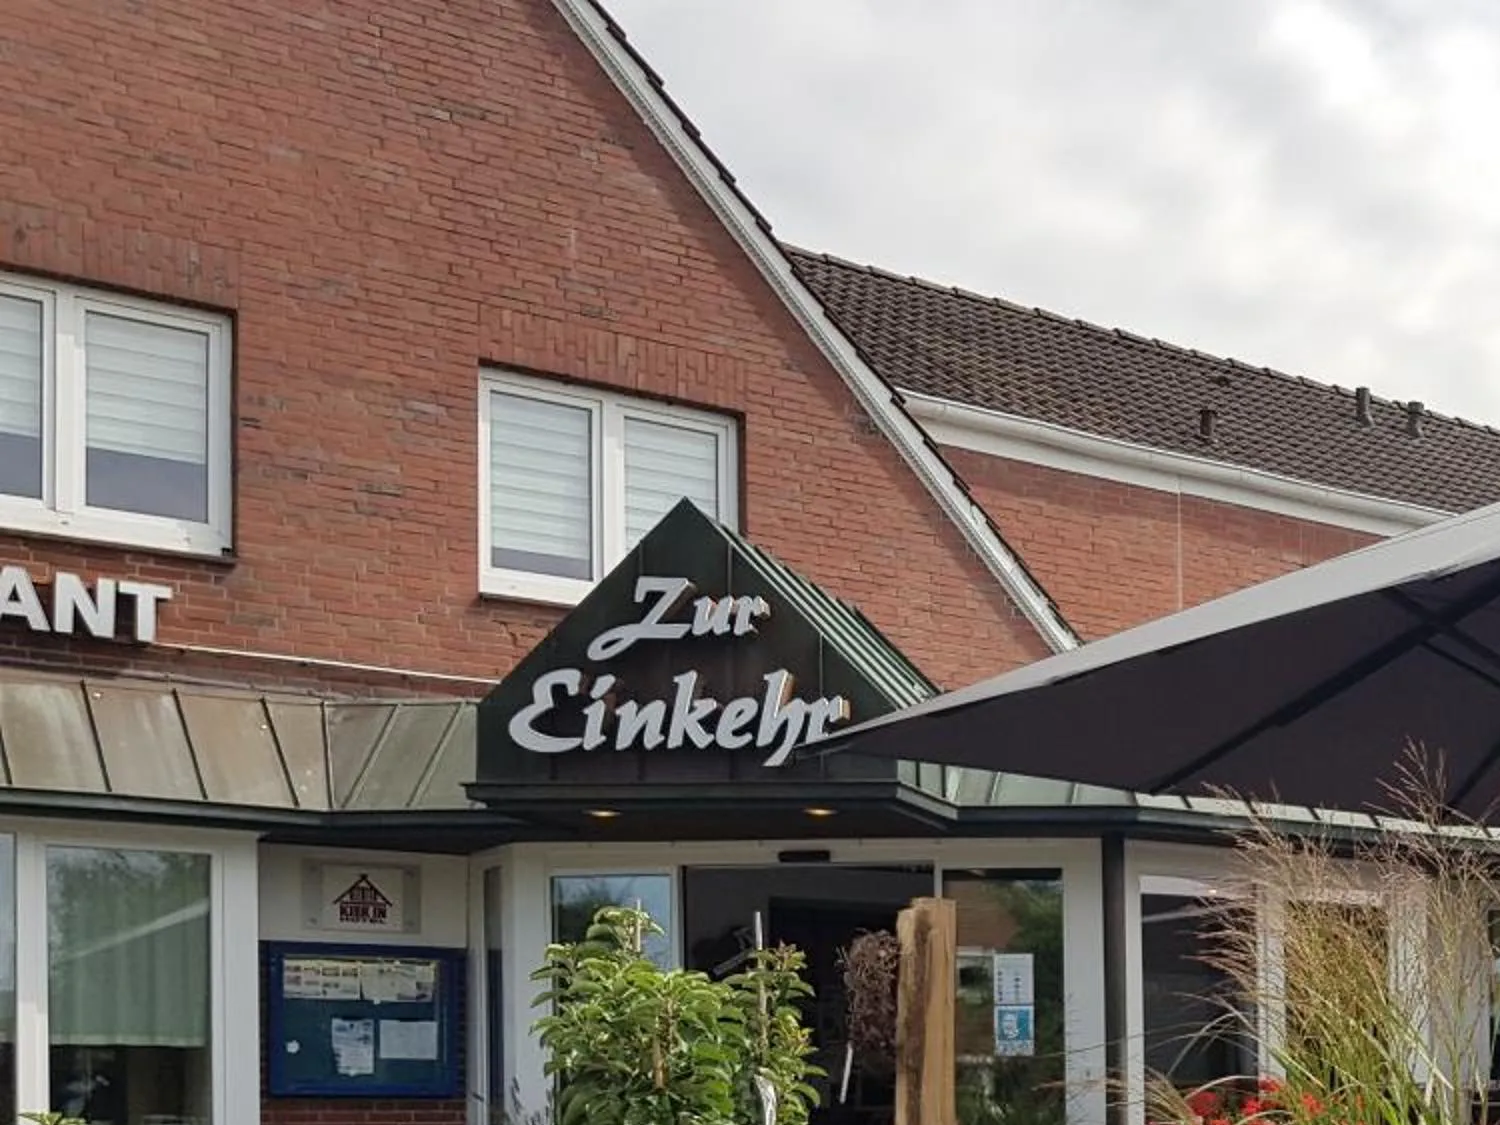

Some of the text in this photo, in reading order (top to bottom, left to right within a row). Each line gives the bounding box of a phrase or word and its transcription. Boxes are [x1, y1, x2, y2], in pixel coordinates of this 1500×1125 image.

[0, 565, 173, 643] ANT
[587, 576, 771, 661] Zur
[508, 668, 850, 767] Einkehr
